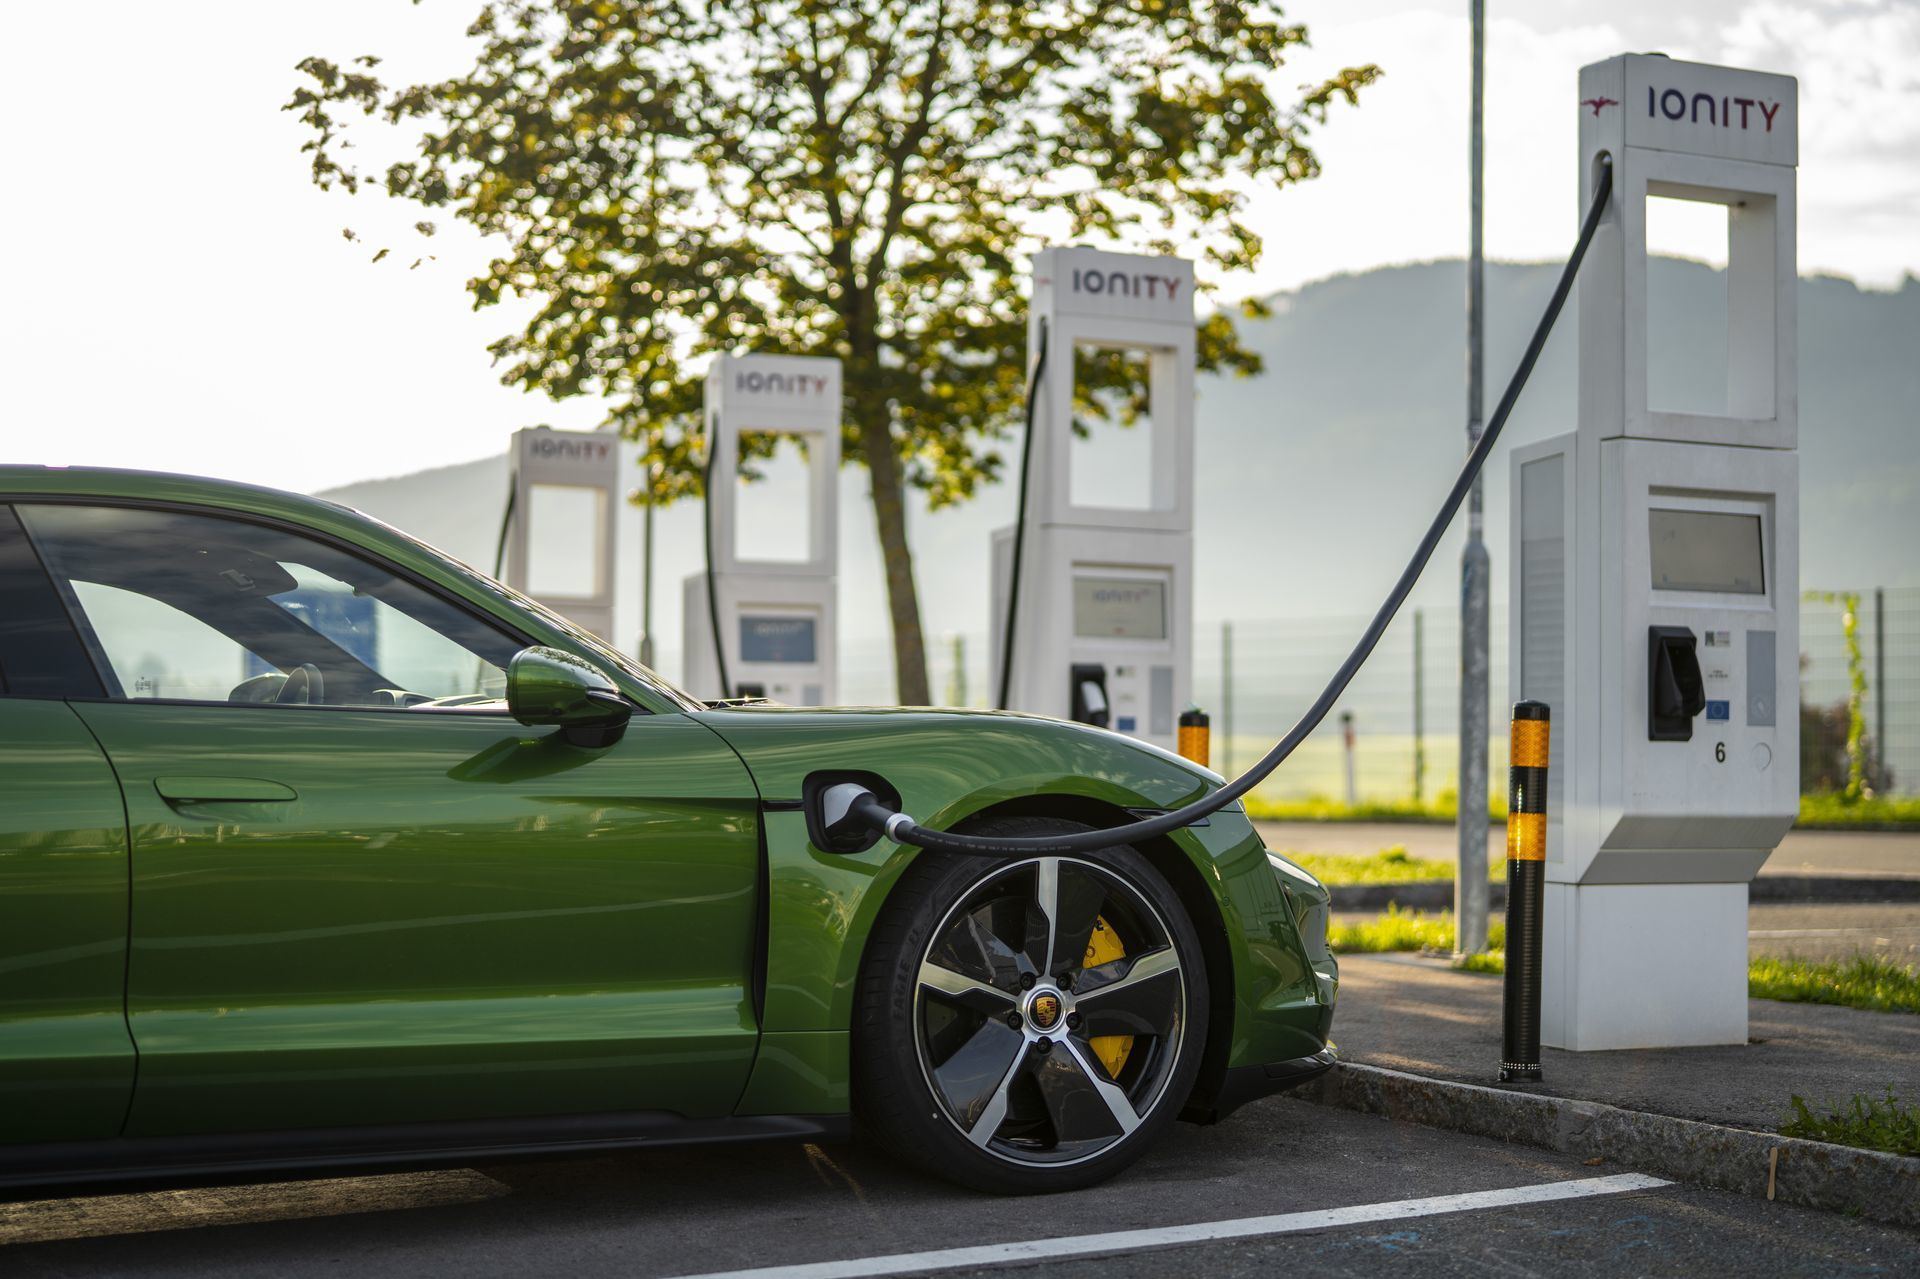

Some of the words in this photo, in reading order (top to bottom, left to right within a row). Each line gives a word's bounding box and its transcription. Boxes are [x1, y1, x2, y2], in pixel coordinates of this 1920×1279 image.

[1648, 85, 1780, 132] IONITY
[1073, 267, 1181, 301] IONITY
[736, 370, 828, 398] IONITY
[1715, 741, 1726, 763] 6
